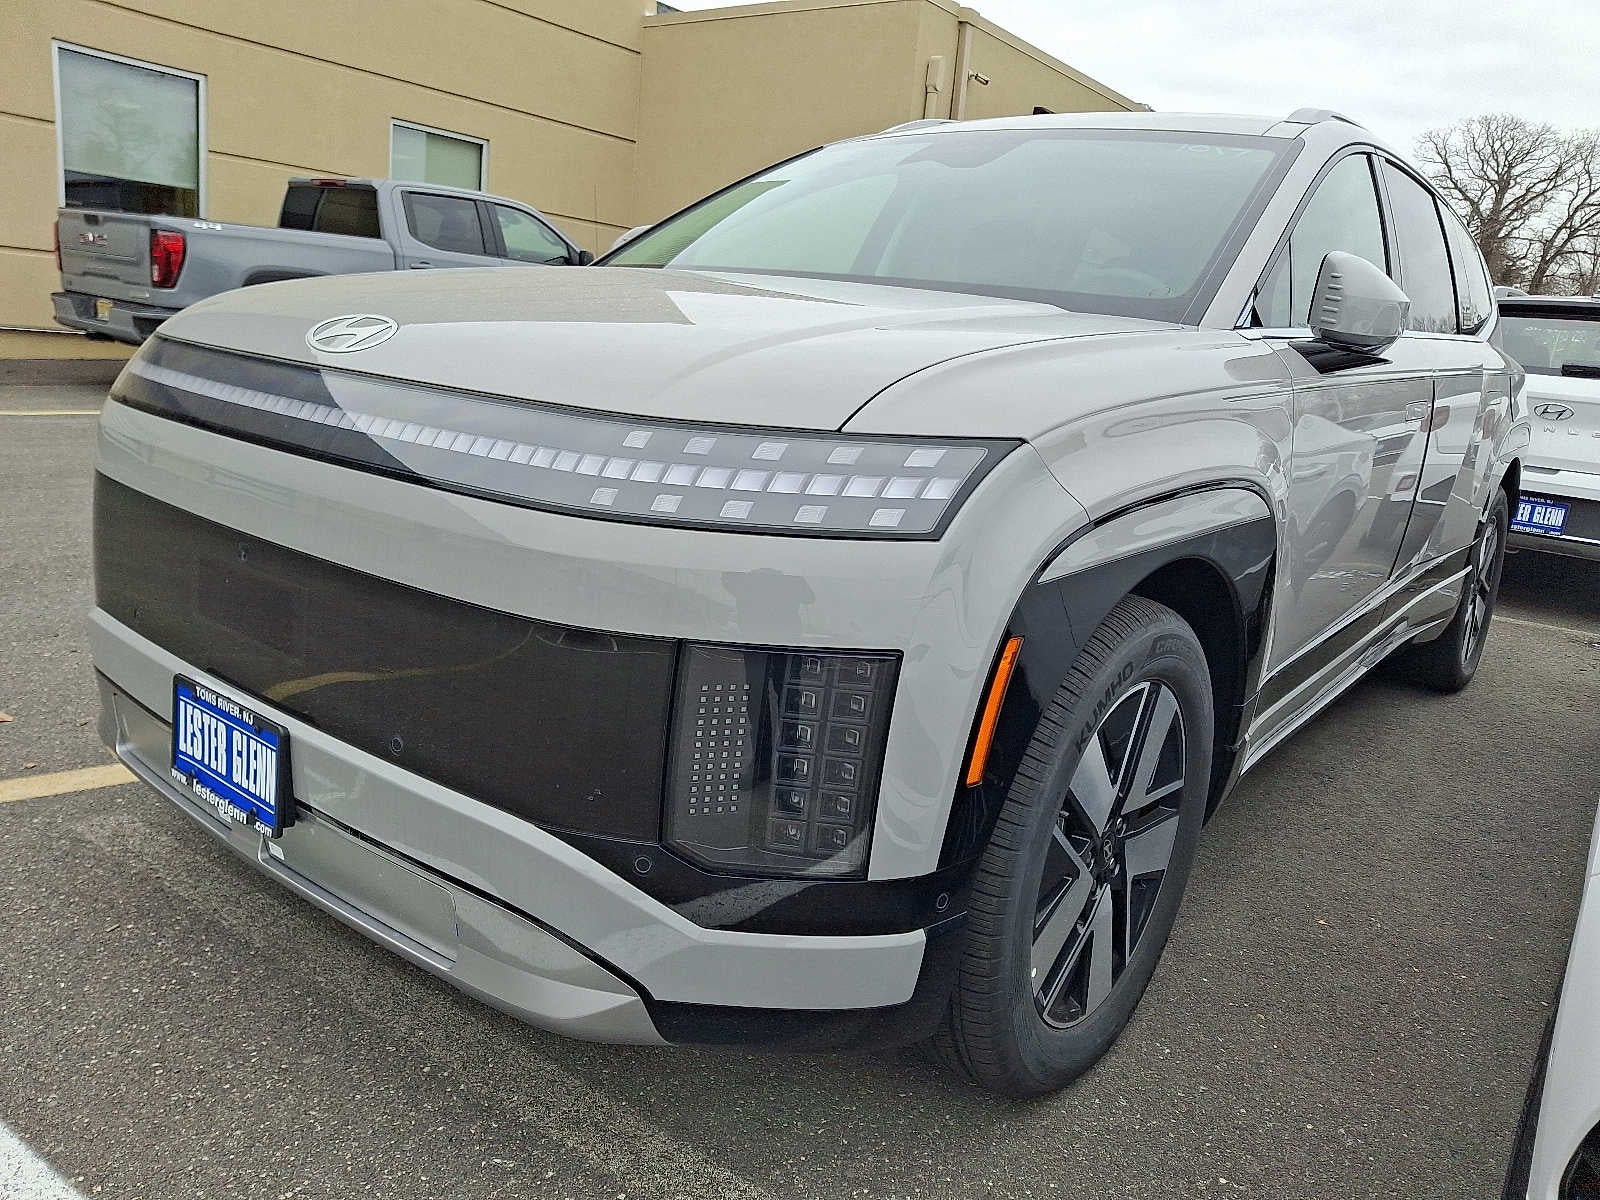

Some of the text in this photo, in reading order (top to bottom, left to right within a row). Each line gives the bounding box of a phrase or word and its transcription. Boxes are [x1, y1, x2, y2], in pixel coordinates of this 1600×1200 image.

[1517, 503, 1566, 526] ER GLENN
[195, 686, 217, 706] TOMS
[243, 710, 254, 726] NJ
[1075, 661, 1135, 753] KUMHO
[178, 700, 277, 806] LESTER GLENN
[171, 768, 272, 838] www. lesterglenn .com
